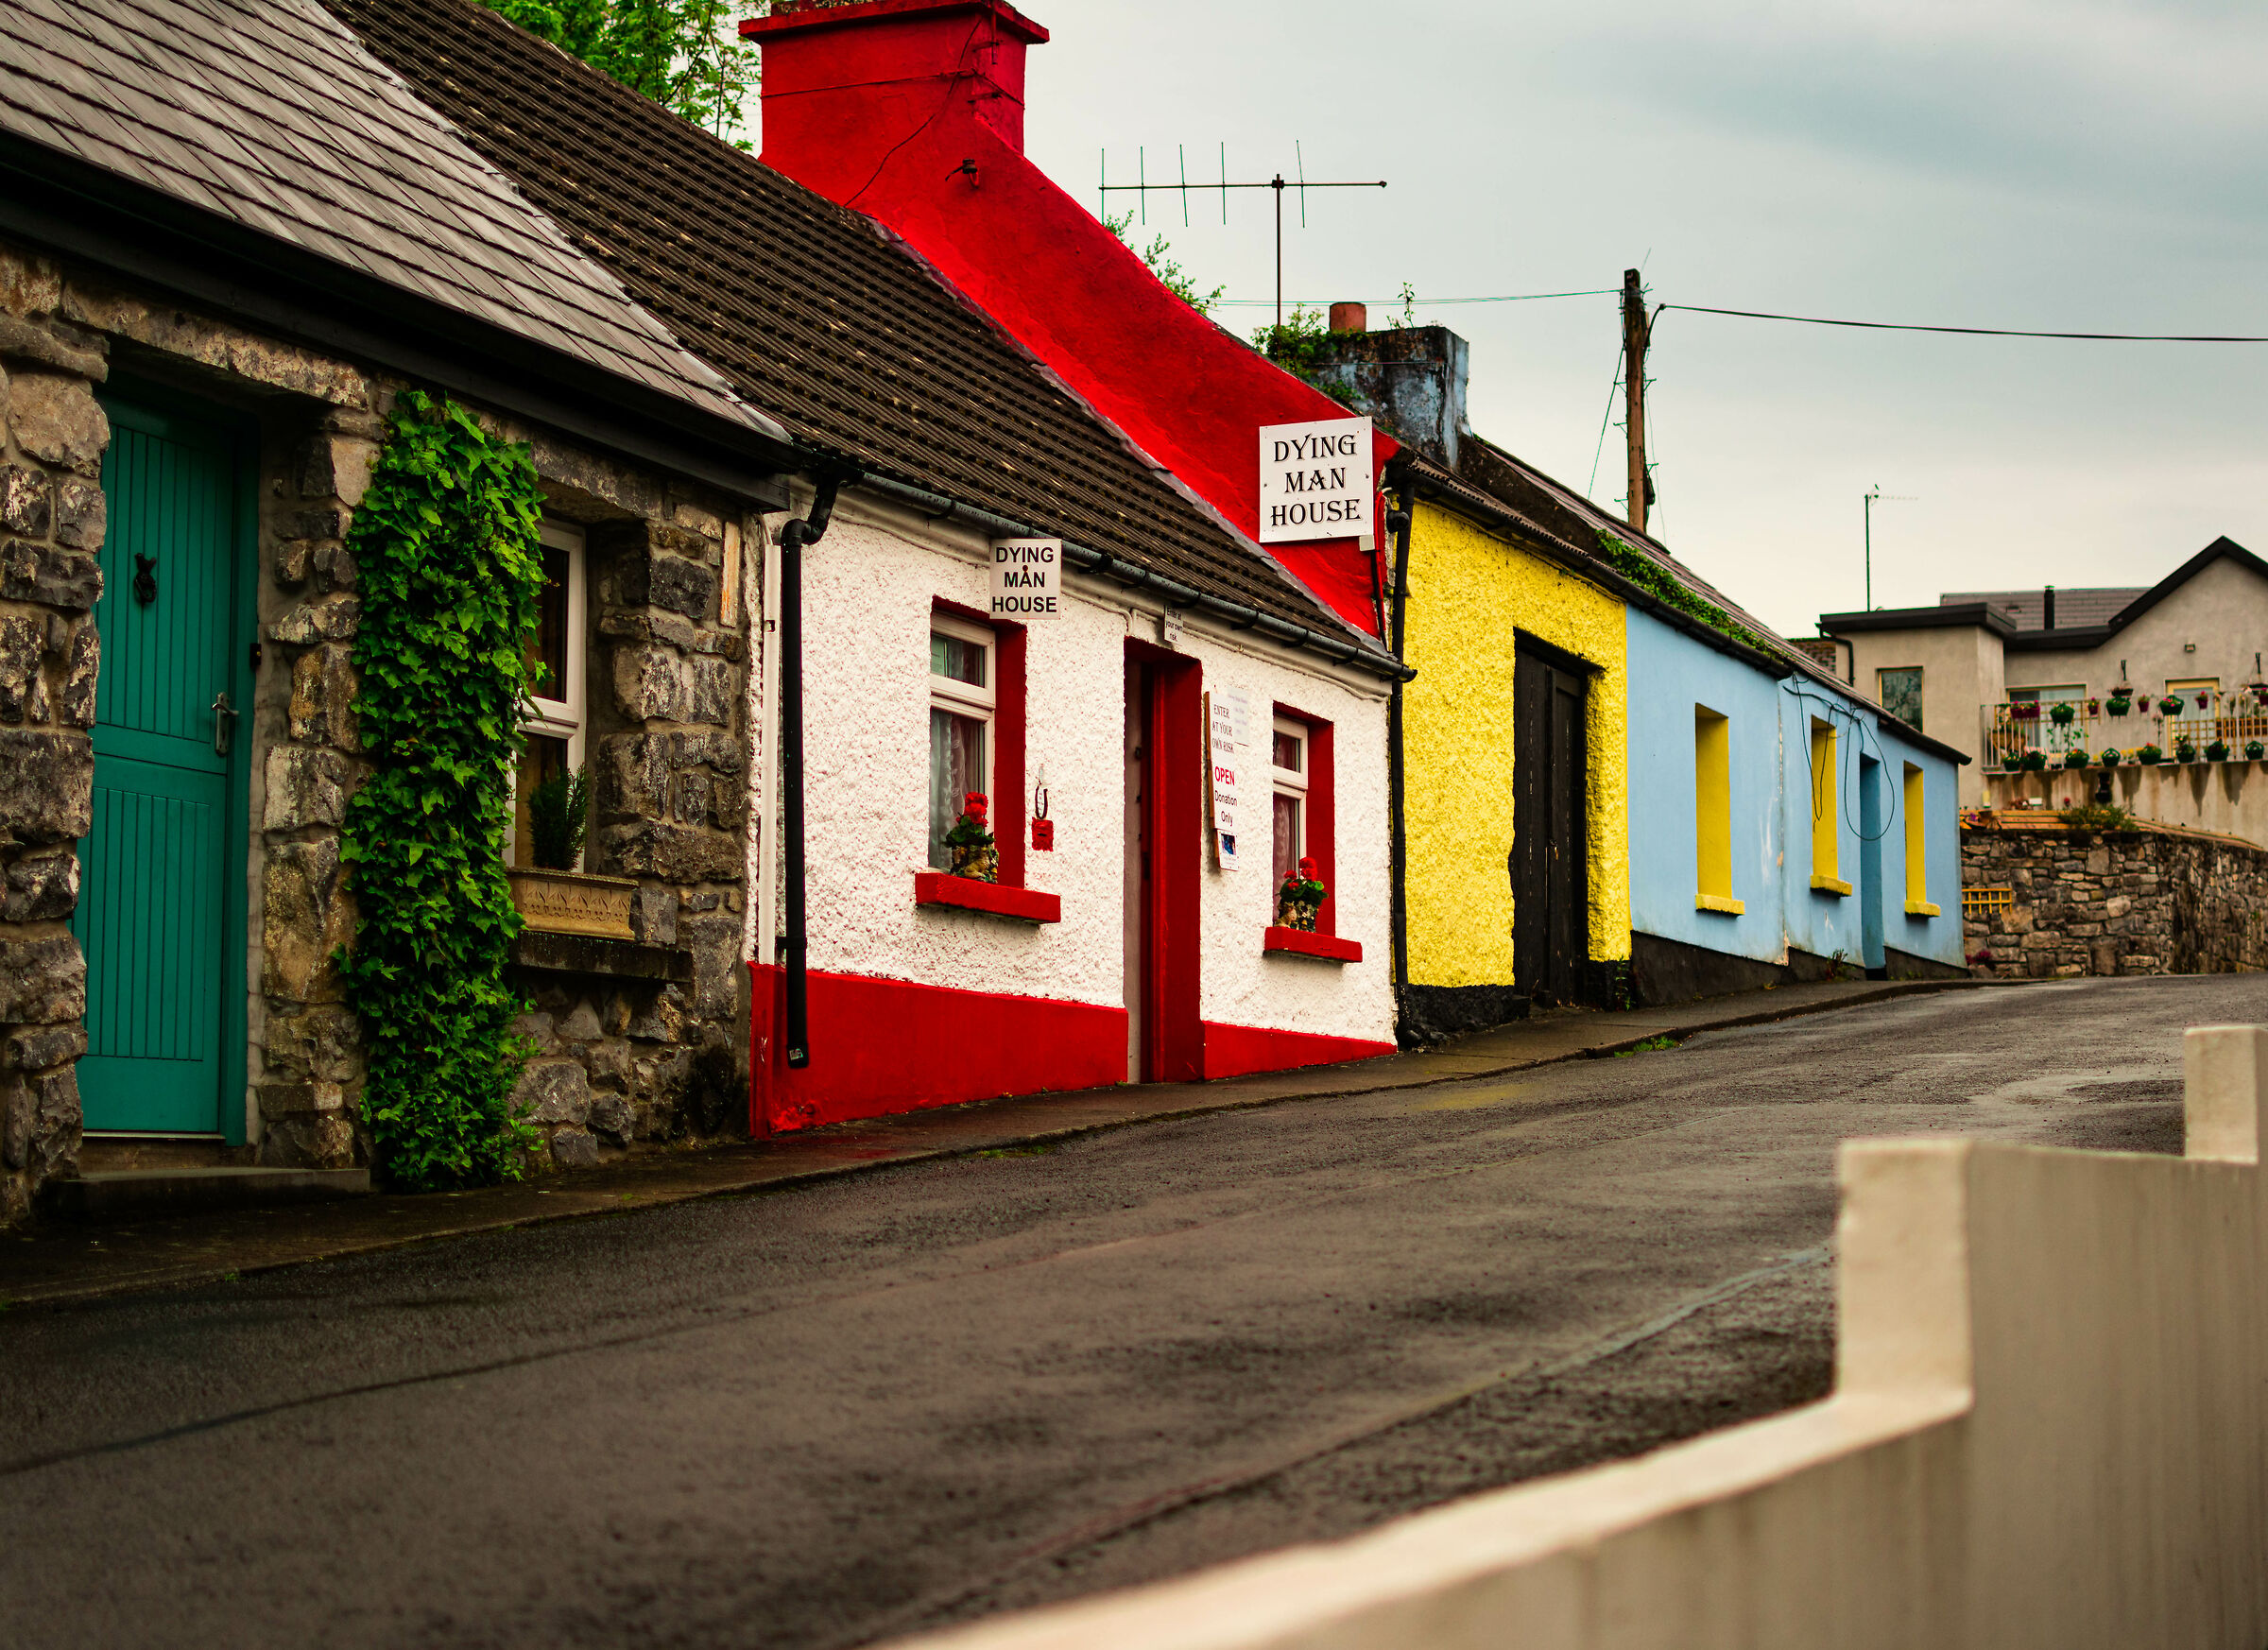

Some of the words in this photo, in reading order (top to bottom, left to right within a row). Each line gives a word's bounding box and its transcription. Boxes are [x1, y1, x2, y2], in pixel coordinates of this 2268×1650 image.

[1274, 433, 1357, 462] DYING
[1284, 467, 1346, 493] MAN
[1270, 499, 1362, 526] HOUSE
[996, 546, 1054, 563] DYING
[1004, 571, 1045, 588] MAN
[991, 595, 1057, 612] HOUSE
[1214, 704, 1229, 718] ENTER
[1212, 720, 1219, 732] AT
[1220, 722, 1233, 737] YOUR
[1212, 738, 1223, 750] OWN
[1223, 741, 1234, 754] RISK
[1214, 766, 1234, 785] OPEN
[1215, 790, 1237, 806] Donation
[1221, 810, 1233, 827] Only
